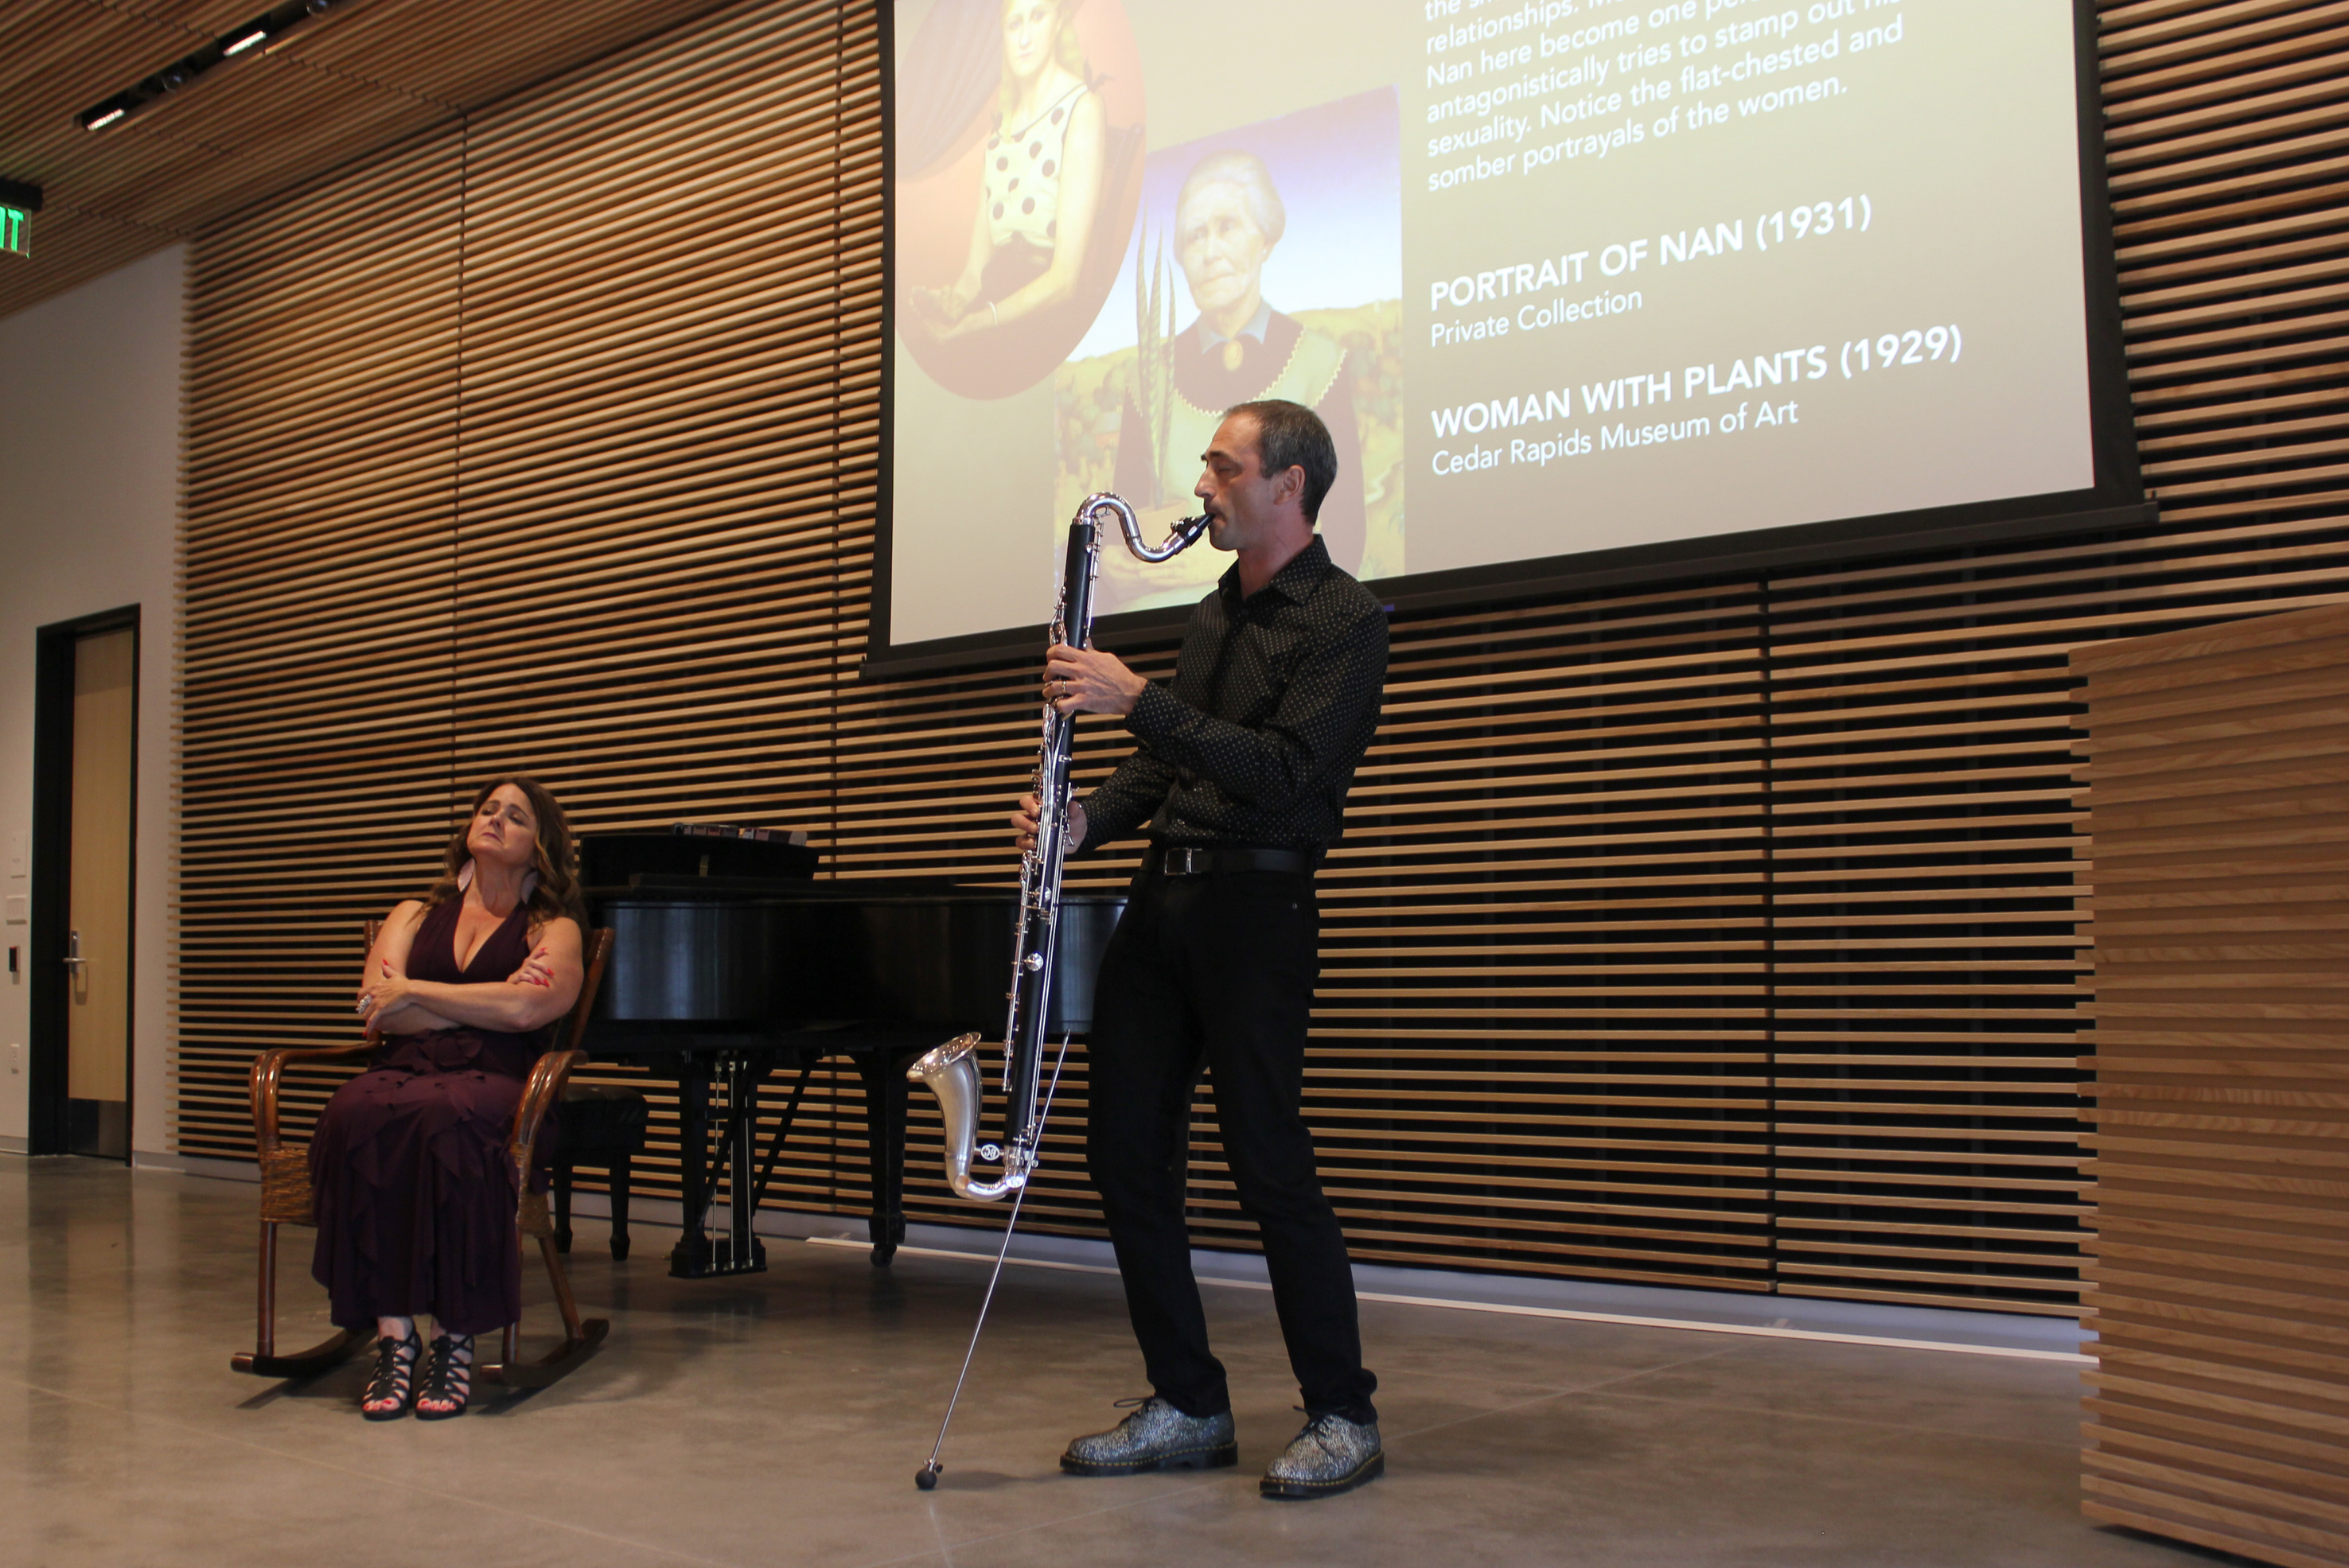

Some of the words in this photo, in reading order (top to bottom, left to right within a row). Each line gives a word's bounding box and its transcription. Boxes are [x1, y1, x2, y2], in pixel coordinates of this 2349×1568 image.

[1424, 0, 1461, 21] the
[1427, 0, 1579, 54] relationships.
[1428, 61, 1472, 88] Nan
[1481, 45, 1533, 73] here
[1541, 16, 1640, 57] become
[1649, 0, 1697, 28] one
[1428, 55, 1610, 123] antagonistically
[1617, 43, 1672, 73] tries
[1679, 34, 1708, 57] to
[1715, 10, 1799, 48] stamp
[1808, 0, 1855, 24] out
[1428, 116, 1531, 157] sexuality.
[1541, 93, 1622, 128] Notice
[1630, 78, 1672, 107] the
[1680, 29, 1840, 93] flat-chested
[1849, 13, 1903, 53] and
[1428, 154, 1516, 192] somber
[1524, 118, 1645, 175] portrayals
[1653, 106, 1679, 138] of
[1686, 101, 1730, 130] the
[1738, 77, 1848, 117] women.
[1431, 251, 1589, 311] PORTRAIT
[1599, 239, 1648, 276] OF
[1660, 220, 1743, 265] NAN
[1756, 194, 1872, 251] (1931)
[1432, 317, 1510, 348] Private
[1517, 290, 1642, 331] Collection
[1431, 388, 1571, 438] WOMAN
[1581, 371, 1672, 414] WITH
[1685, 345, 1828, 399] PLANTS
[1841, 324, 1962, 379] (1929)
[1432, 444, 1503, 476] Cedar
[1510, 428, 1592, 467] Rapids
[1601, 417, 1711, 450] Museum
[1720, 402, 1748, 434] of
[1755, 401, 1799, 428] Art
